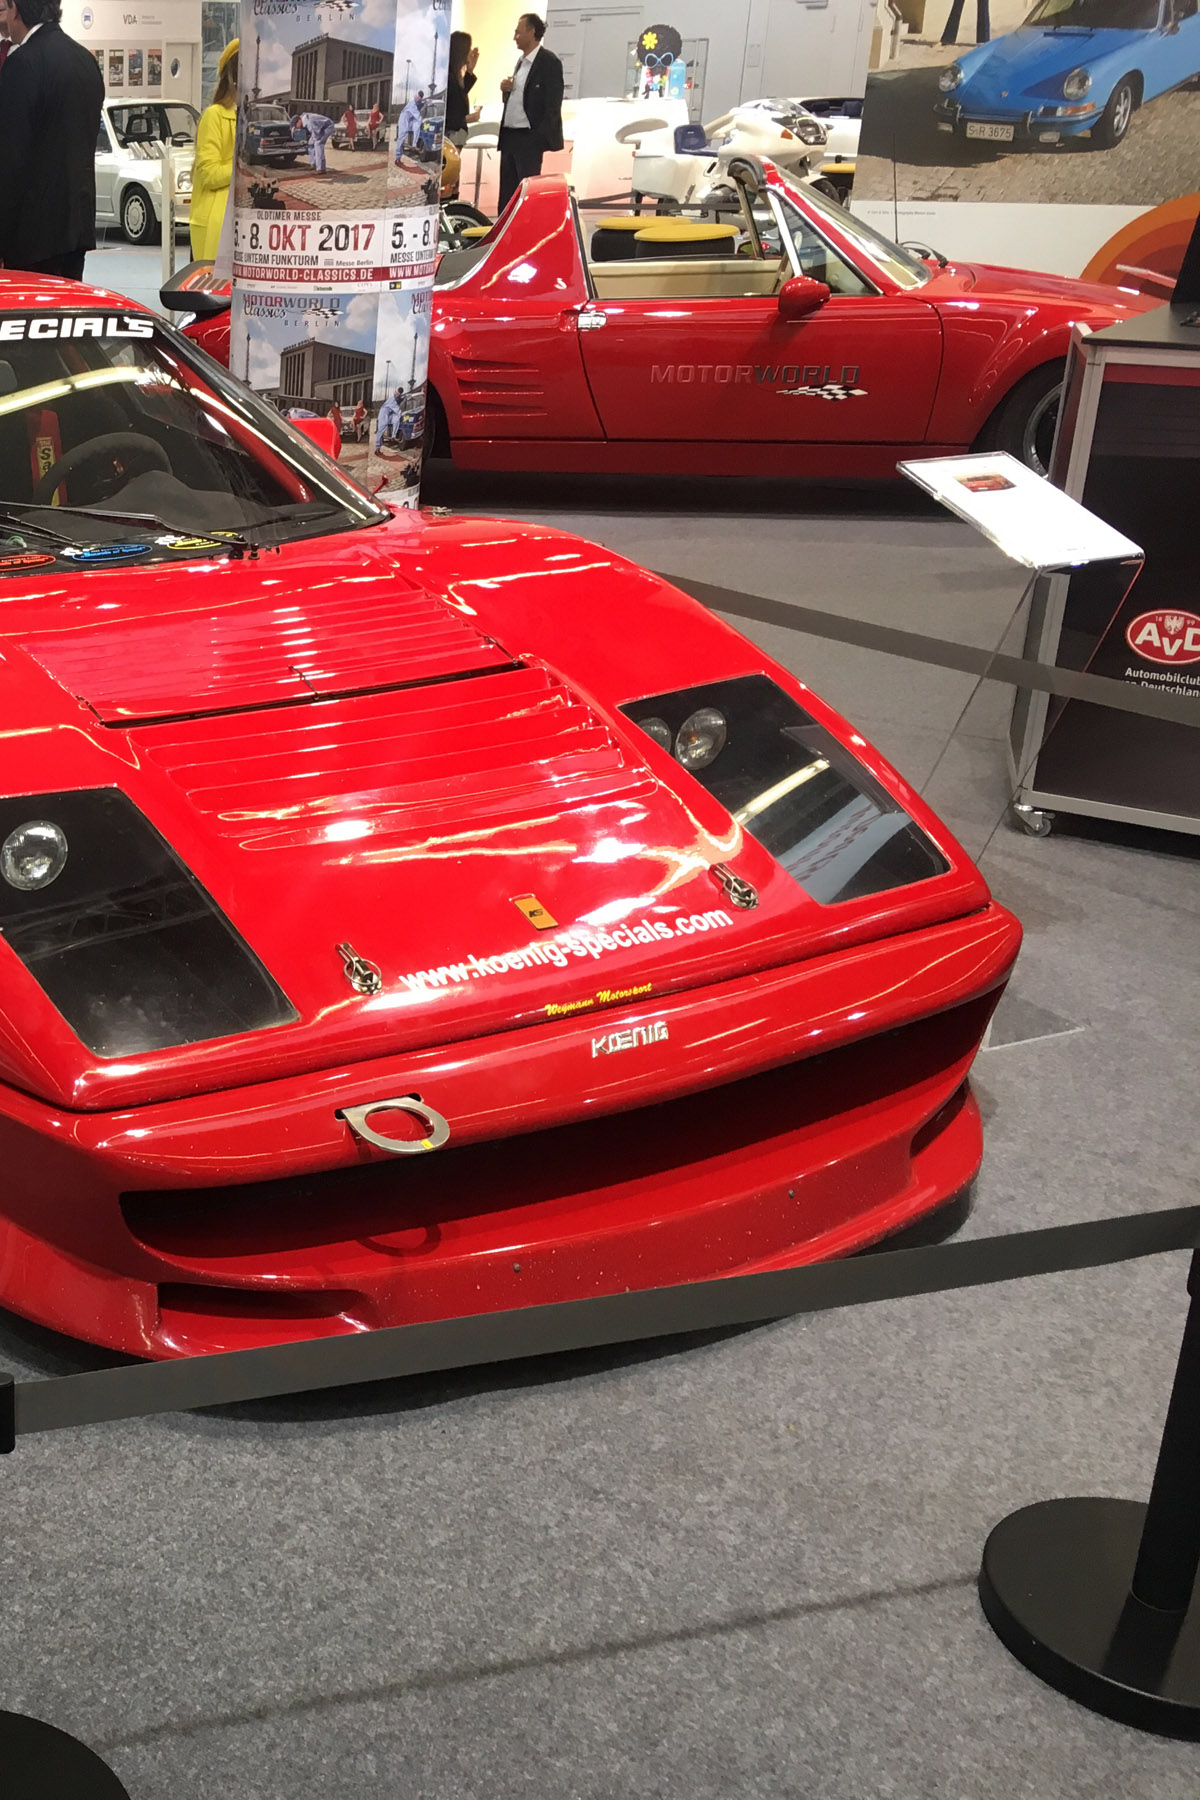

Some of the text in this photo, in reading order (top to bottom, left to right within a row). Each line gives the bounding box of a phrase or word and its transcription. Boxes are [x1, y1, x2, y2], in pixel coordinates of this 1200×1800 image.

[123, 14, 137, 25] VDA
[296, 13, 355, 22] BERLIN
[257, 211, 322, 221] OLDTIMER MESSE
[268, 224, 311, 251] OKT
[318, 224, 376, 252] 2017
[271, 254, 319, 266] FUNKTURM
[357, 258, 373, 266] Berlin
[390, 251, 414, 263] MESSE
[243, 294, 340, 309] MOTORWORLD
[284, 320, 340, 328] BERLIN
[650, 365, 860, 384] MOTORWORLD
[399, 907, 734, 992] www.koenig-specials.com
[544, 982, 652, 1016] Weymann Motorsport
